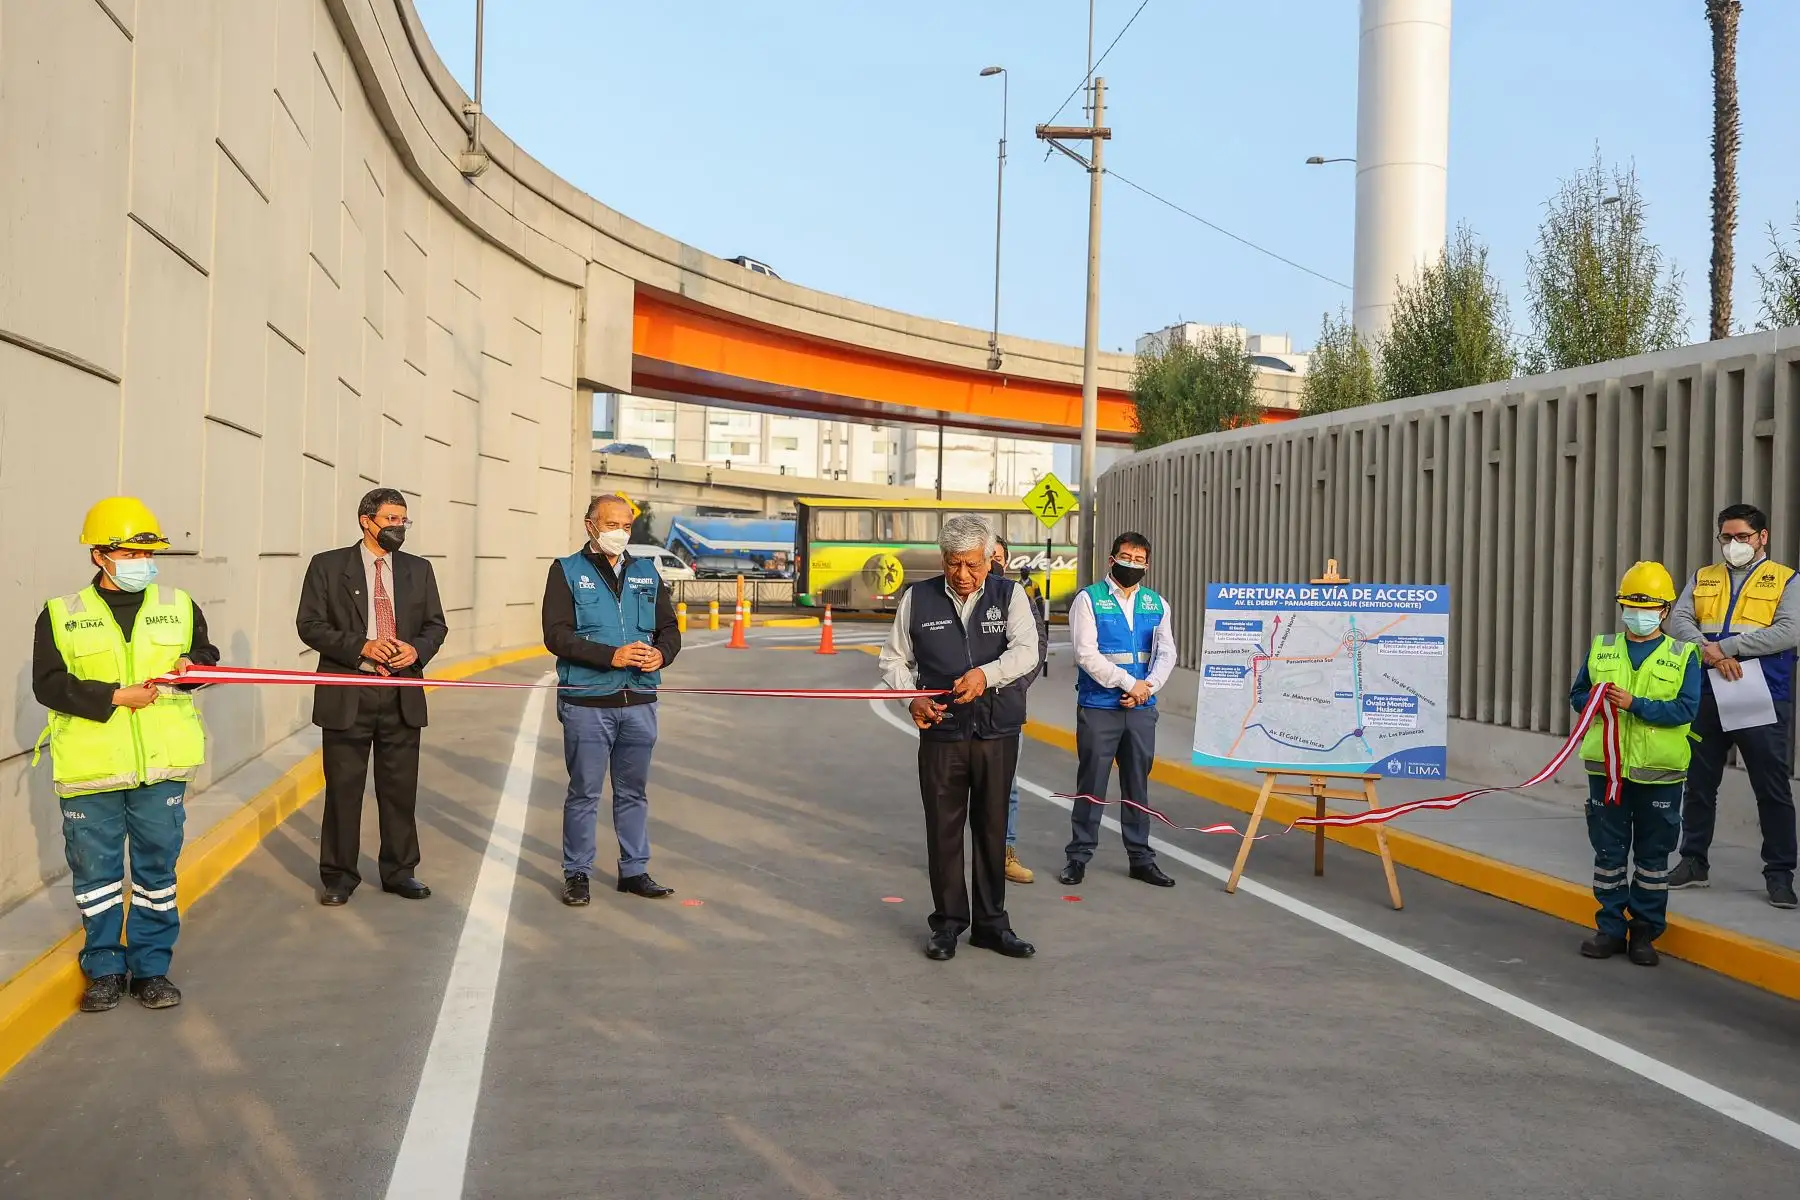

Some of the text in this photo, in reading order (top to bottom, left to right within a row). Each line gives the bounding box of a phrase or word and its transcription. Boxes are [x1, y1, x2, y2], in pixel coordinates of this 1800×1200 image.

[1218, 586, 1438, 602] APERTURA DE VÍA DE ACCESO
[145, 615, 168, 625] EMAPE
[80, 620, 105, 629] LIMA
[1292, 693, 1312, 701] Manuel
[1387, 700, 1415, 708] Monitor
[1399, 729, 1424, 737] Palmeras
[1310, 740, 1325, 748] Incas
[1408, 767, 1441, 776] LIMA
